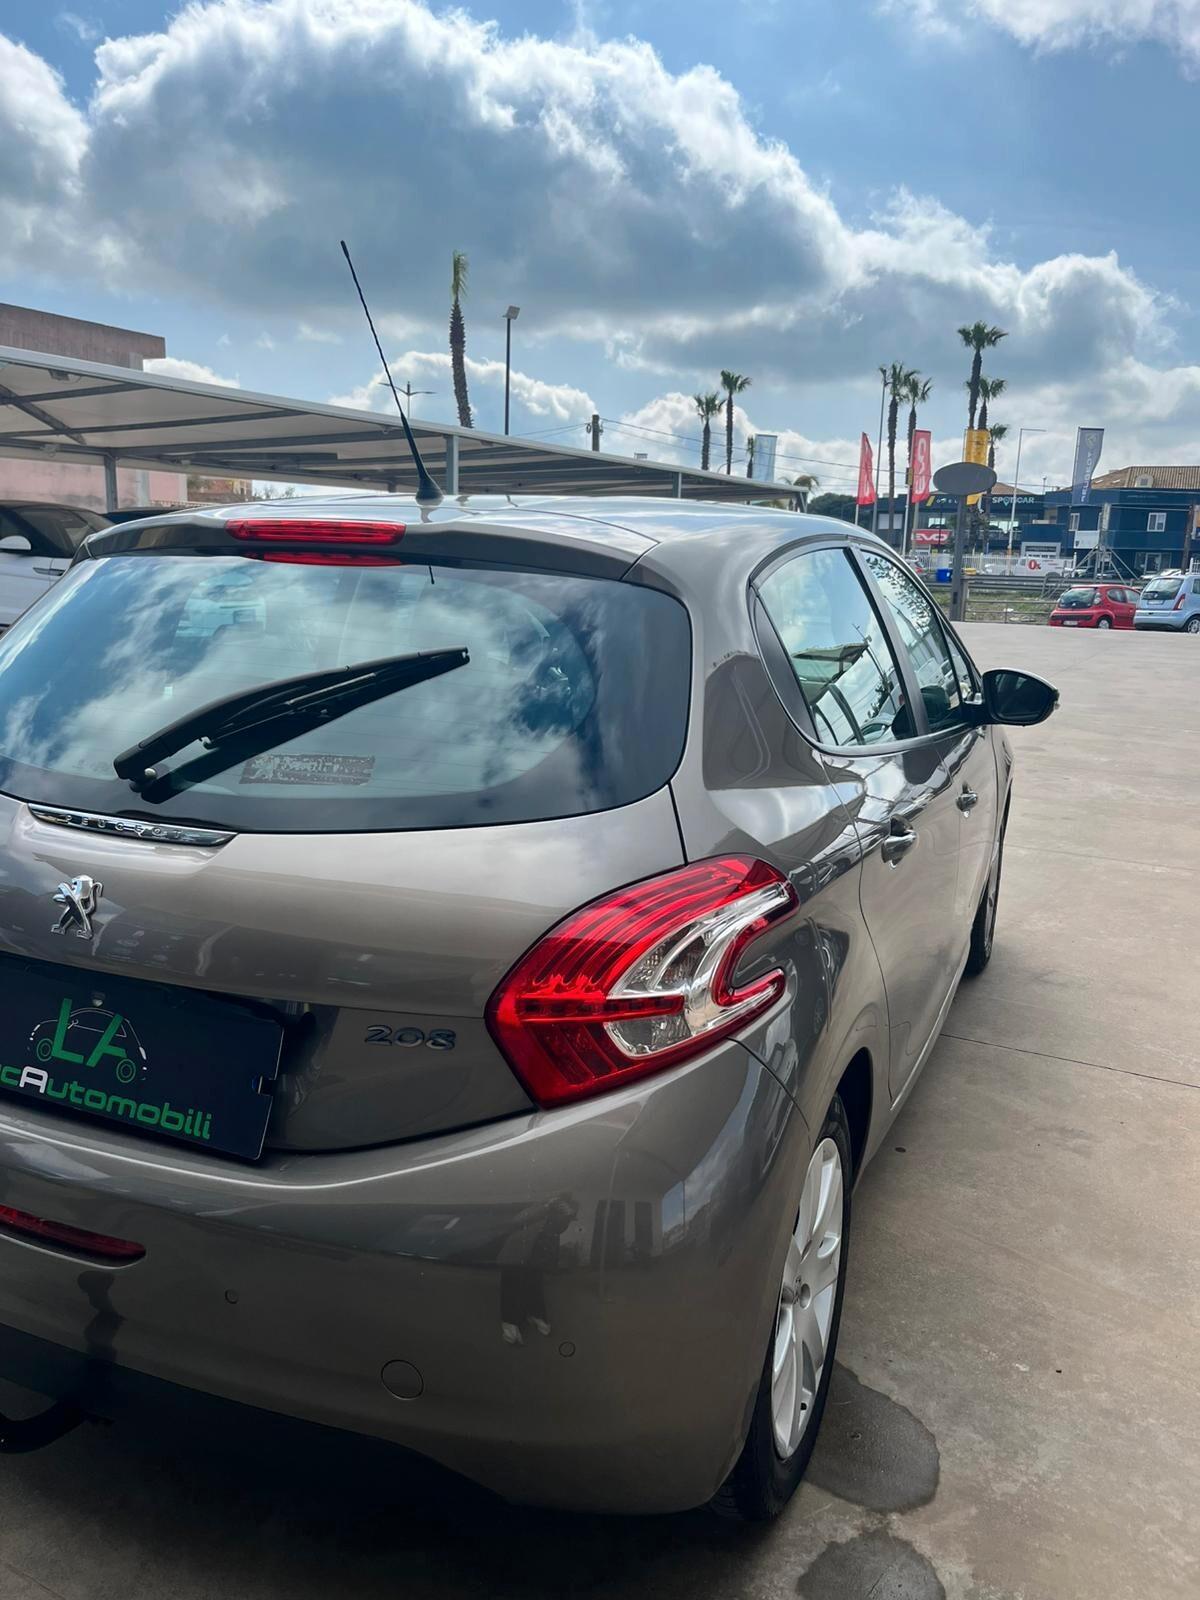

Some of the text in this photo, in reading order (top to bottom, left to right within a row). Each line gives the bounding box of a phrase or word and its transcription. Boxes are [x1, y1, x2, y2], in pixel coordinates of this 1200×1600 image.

[991, 496, 1035, 506] SPOTCAR
[65, 813, 183, 839] PEUGEOT
[364, 1024, 457, 1051] 208
[0, 1064, 213, 1140] cAutomobili
